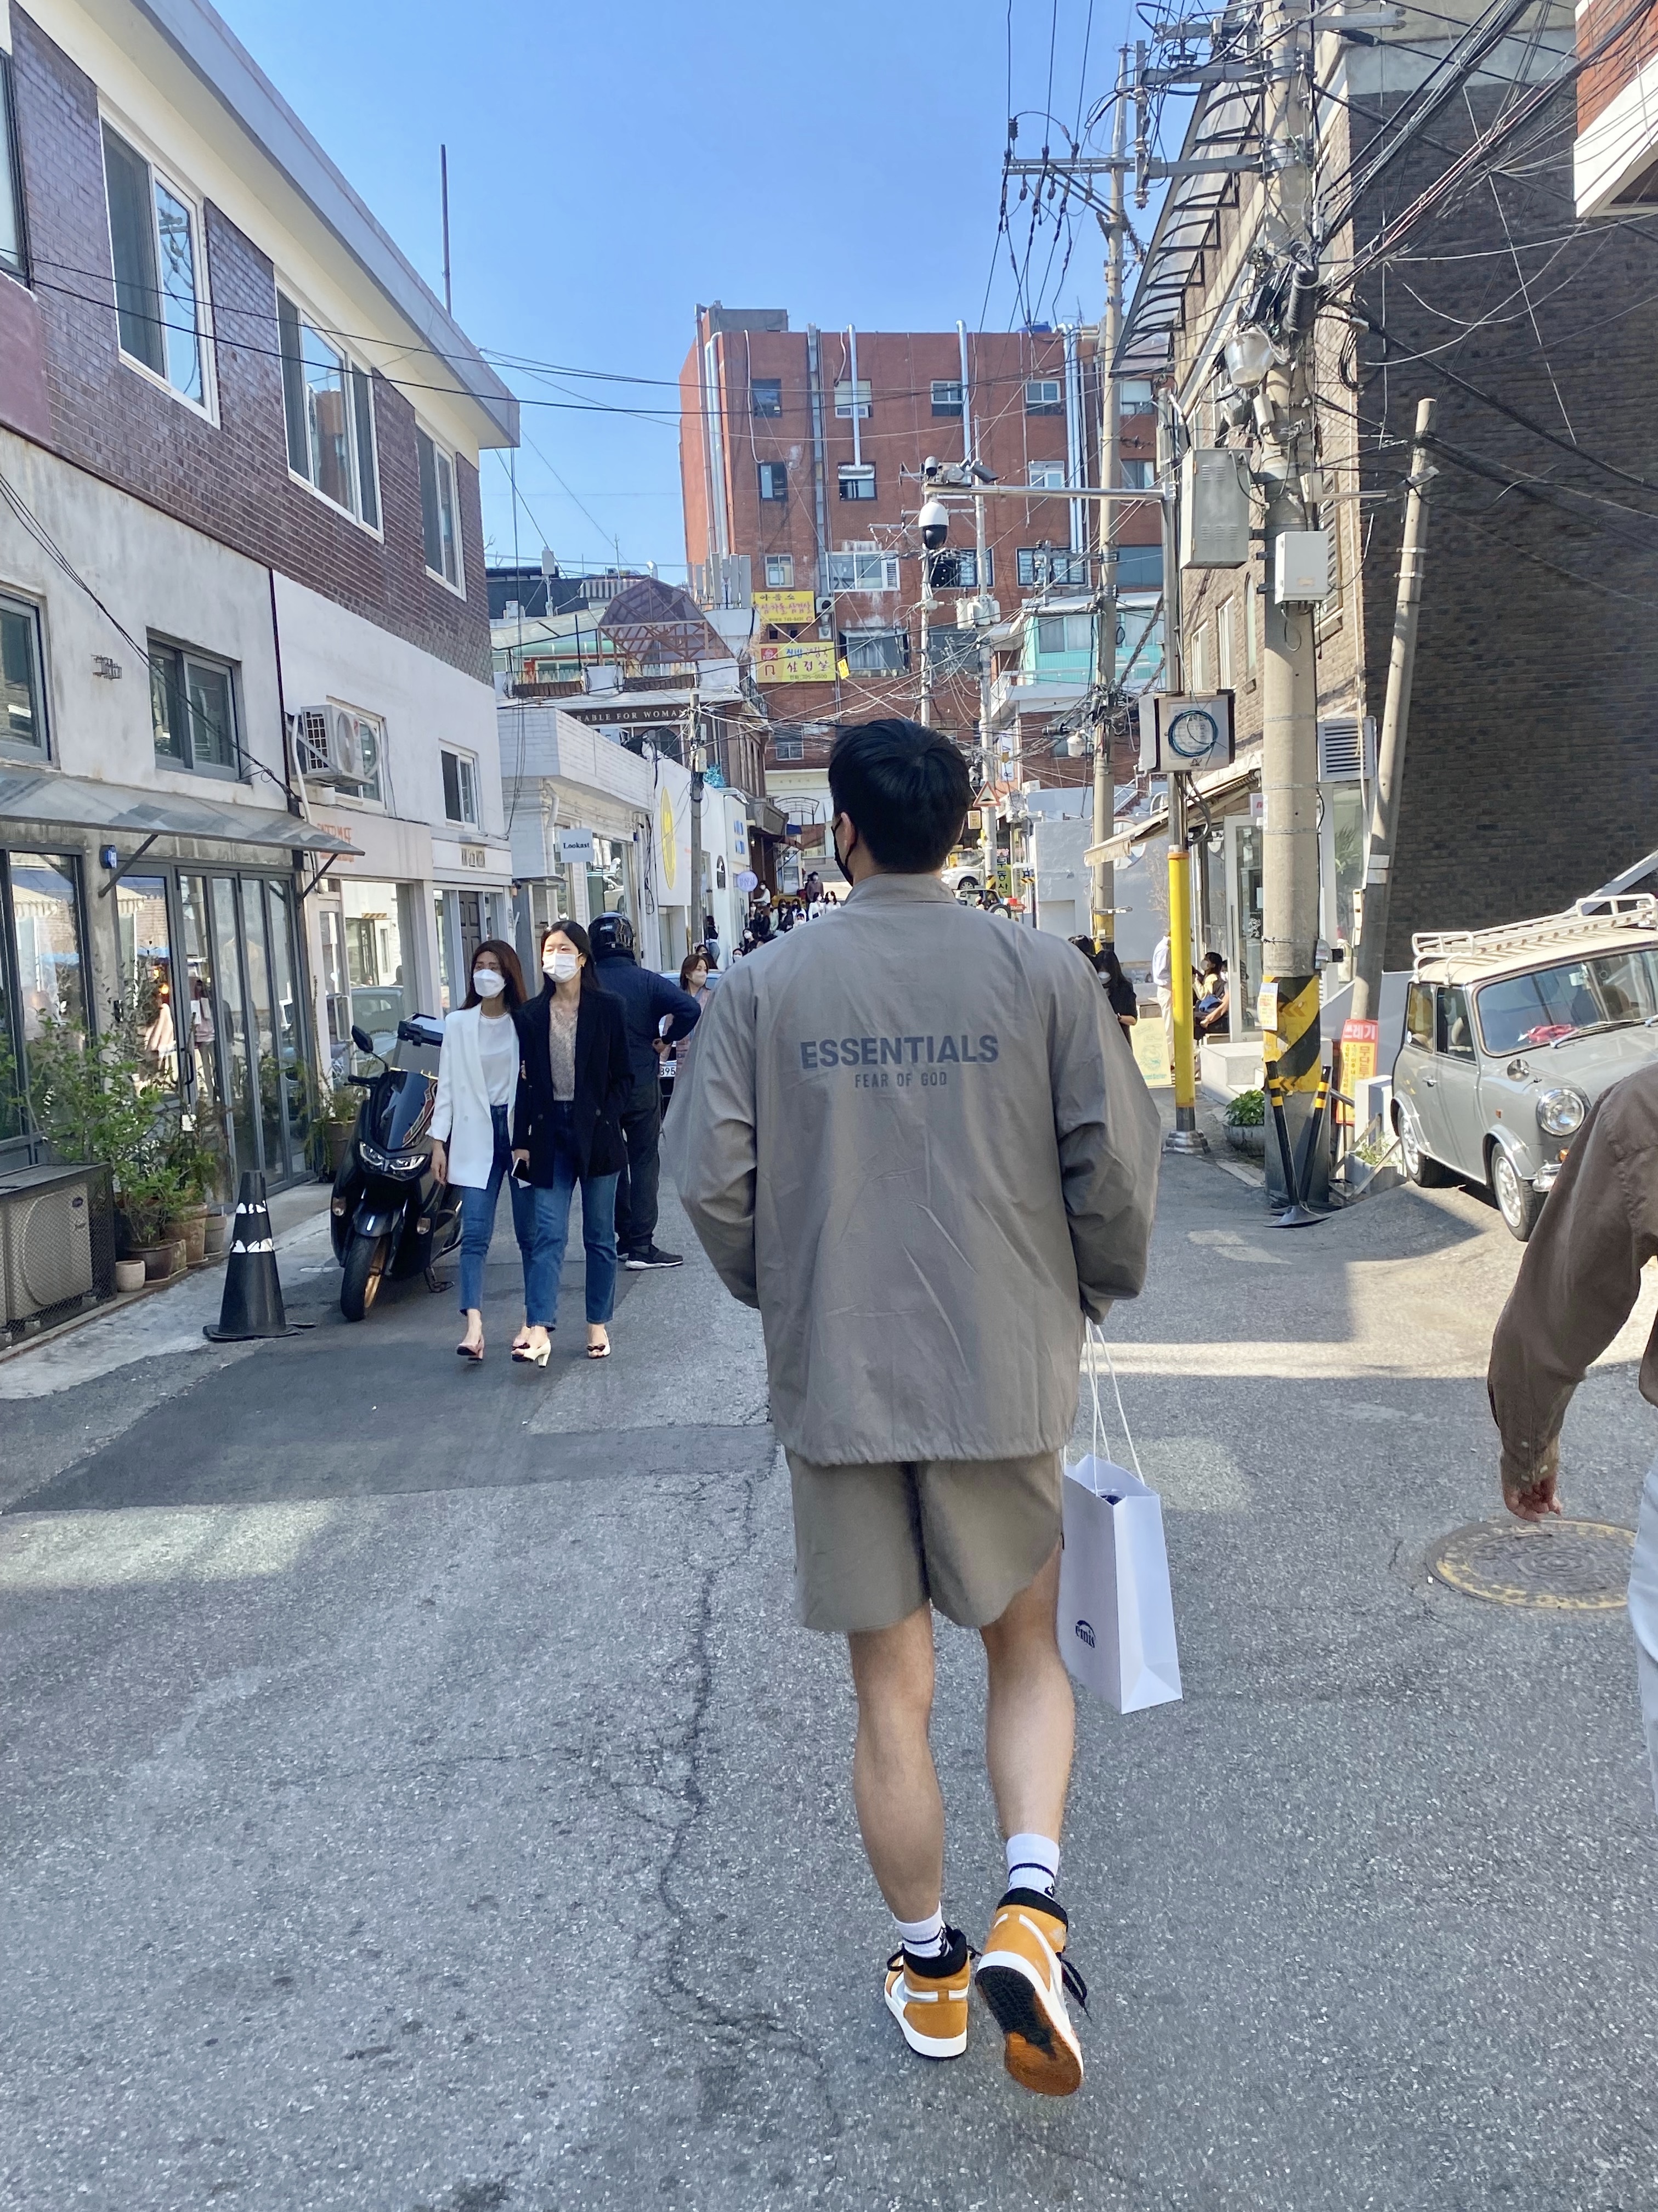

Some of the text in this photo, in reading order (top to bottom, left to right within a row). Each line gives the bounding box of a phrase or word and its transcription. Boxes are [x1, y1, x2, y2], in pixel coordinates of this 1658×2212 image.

[616, 712, 637, 720] FOR
[1344, 1025, 1376, 1040] 쓰레기
[800, 1034, 998, 1069] ESSENTIALS
[855, 1071, 947, 1088] FEAR OF GOD
[1075, 1625, 1095, 1648] emis
